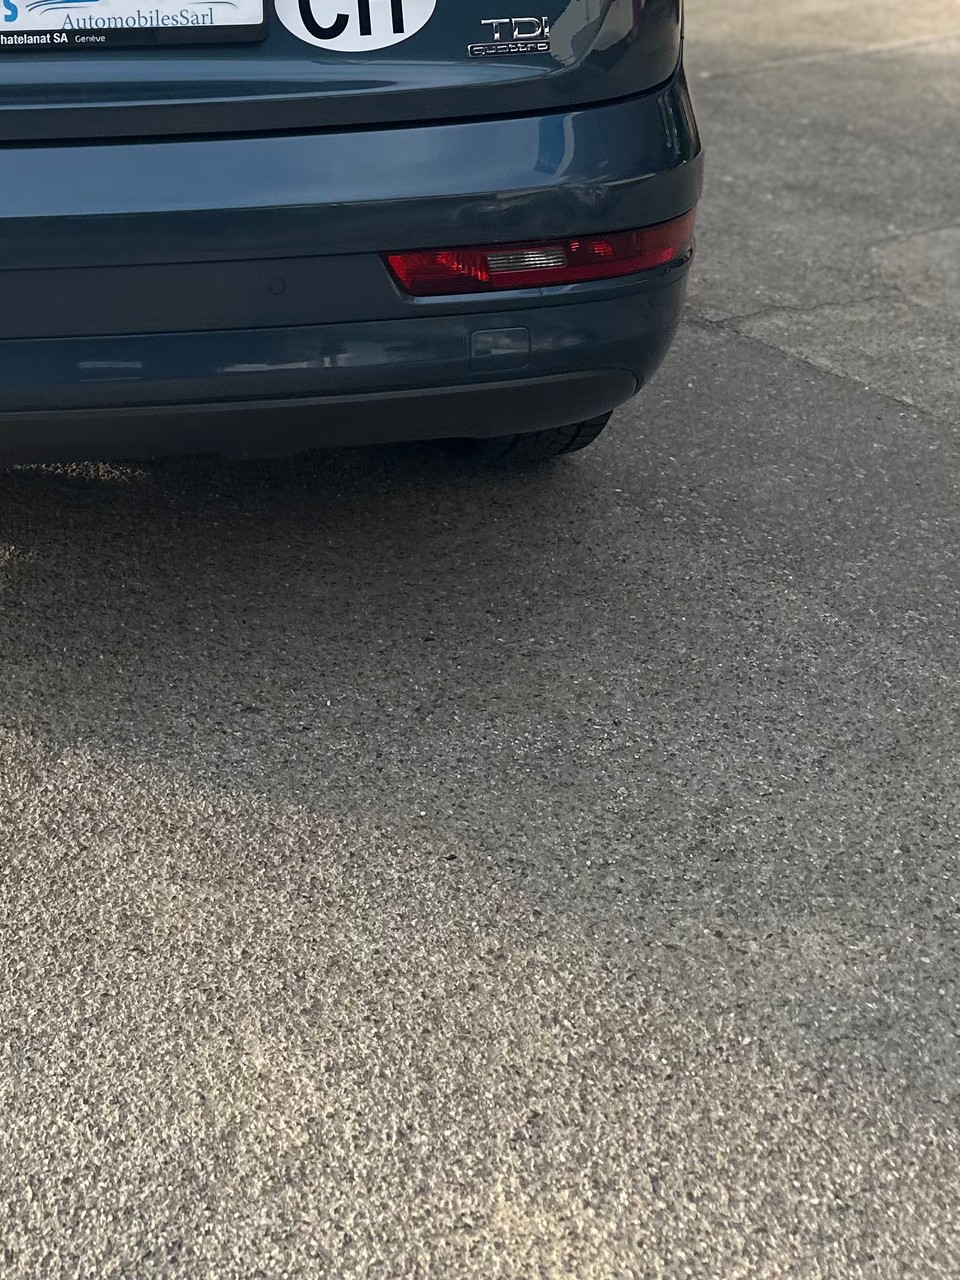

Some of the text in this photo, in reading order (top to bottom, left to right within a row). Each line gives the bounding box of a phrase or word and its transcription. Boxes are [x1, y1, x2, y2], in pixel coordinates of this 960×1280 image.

[480, 16, 550, 41] TDI
[53, 32, 69, 43] SA
[74, 34, 106, 43] Genève
[472, 43, 549, 55] quattro
